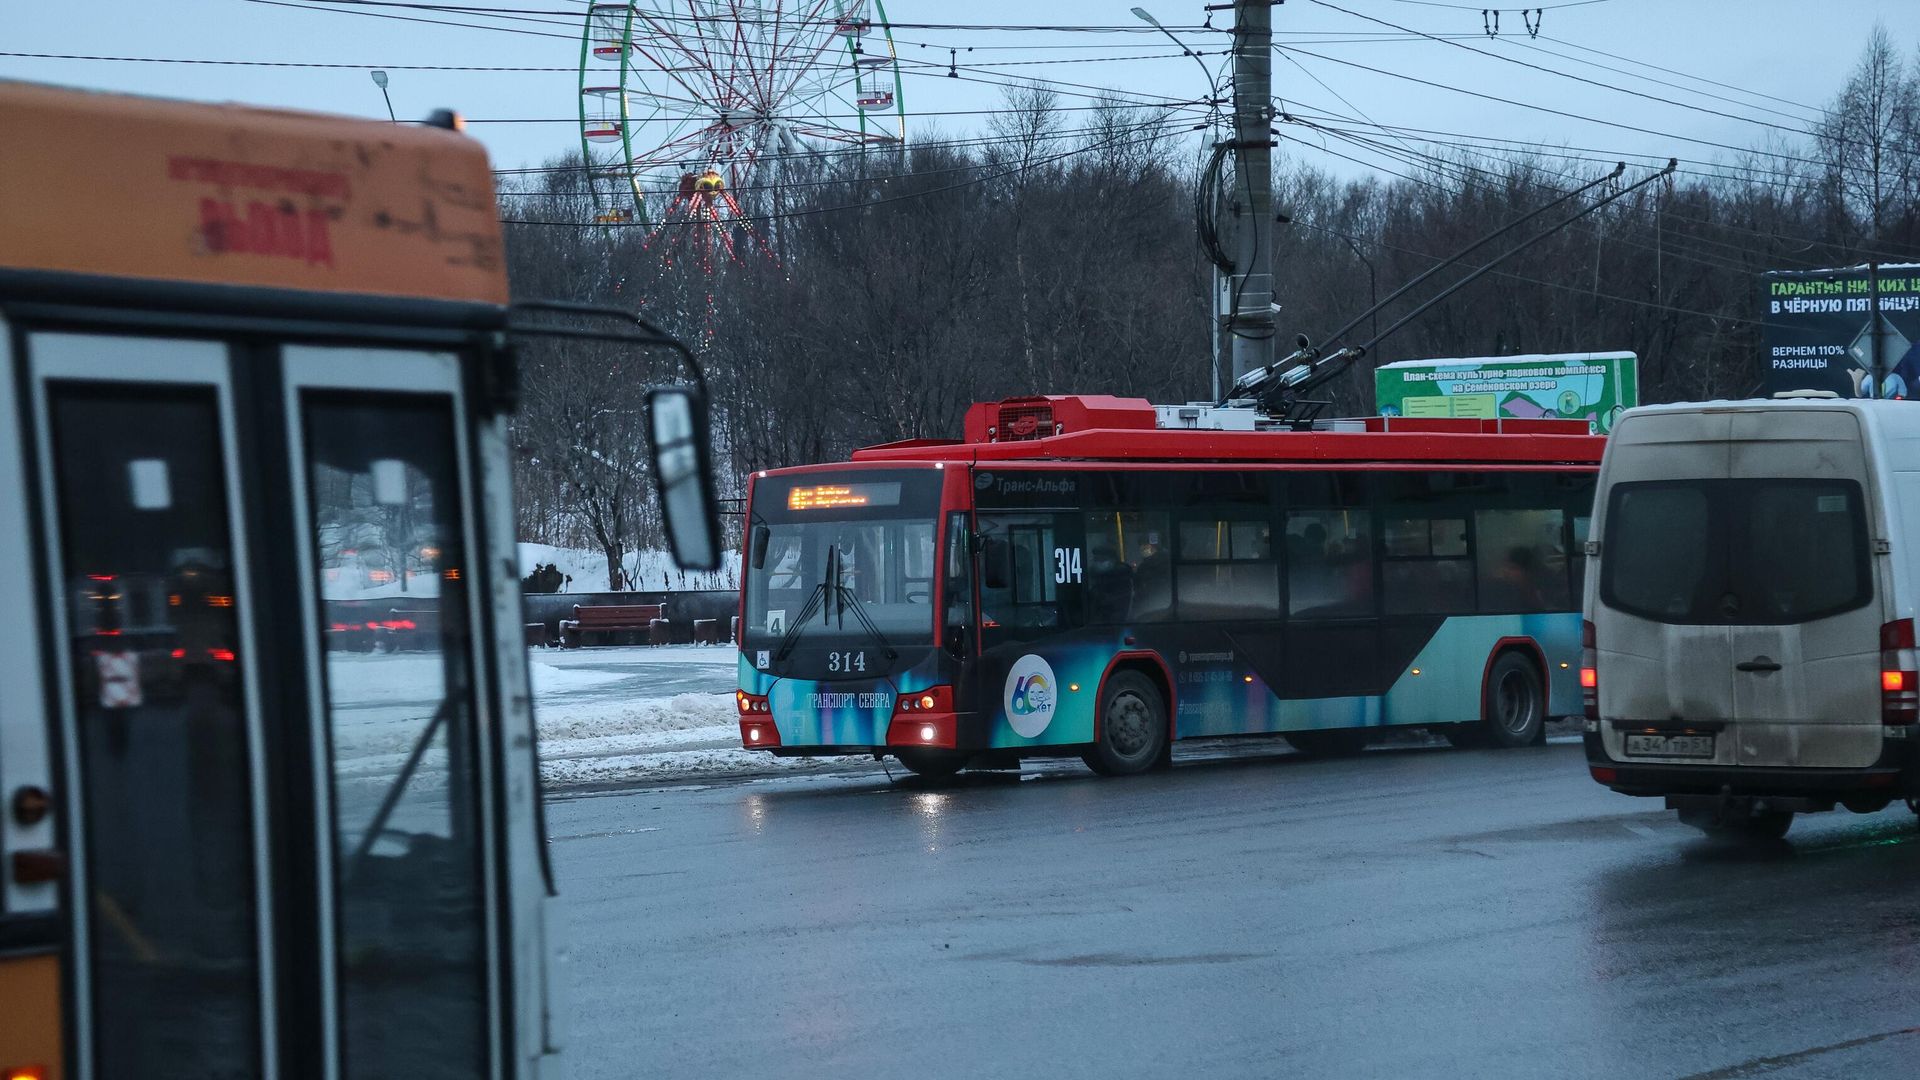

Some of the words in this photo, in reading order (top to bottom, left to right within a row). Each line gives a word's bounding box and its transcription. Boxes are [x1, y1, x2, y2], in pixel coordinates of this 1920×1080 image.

[1771, 280, 1843, 295] ГАРАНТИЯ
[1848, 279, 1906, 293] НИКИХ
[1771, 301, 1780, 313] В
[1784, 298, 1842, 313] ЧЁРНУЮ
[1772, 346, 1816, 356] ВЕРНЕМ
[1819, 346, 1845, 356] 110%
[1772, 359, 1828, 369] РАЗНИЦЫ
[1452, 384, 1463, 393] на
[1529, 380, 1556, 391] озере
[997, 477, 1076, 495] Транс-Альфа
[1054, 547, 1082, 584] 314
[771, 618, 782, 635] 4
[828, 651, 866, 672] 314
[807, 693, 855, 709] ТРАНСПОРТ
[858, 693, 890, 708] СЕВЕРА
